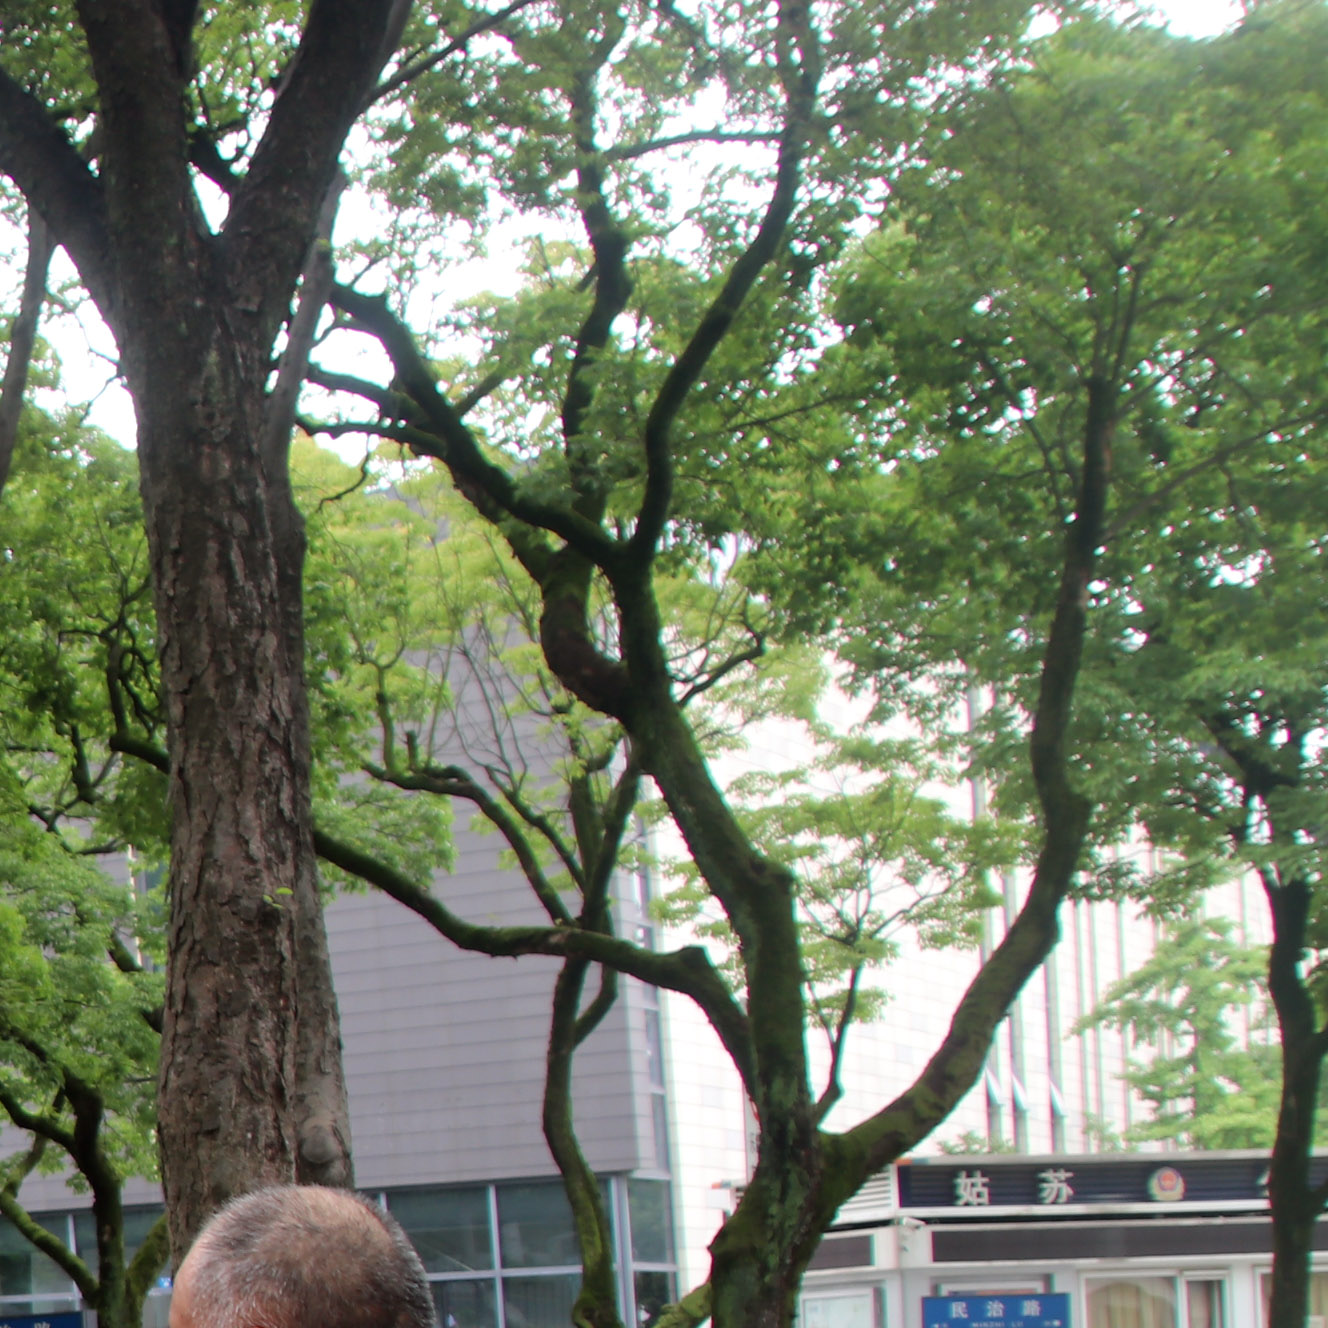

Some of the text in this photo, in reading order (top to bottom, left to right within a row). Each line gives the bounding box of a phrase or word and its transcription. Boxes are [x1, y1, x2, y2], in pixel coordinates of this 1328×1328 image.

[955, 1169, 1074, 1206] 姑苏
[951, 1300, 1042, 1318] 民治路
